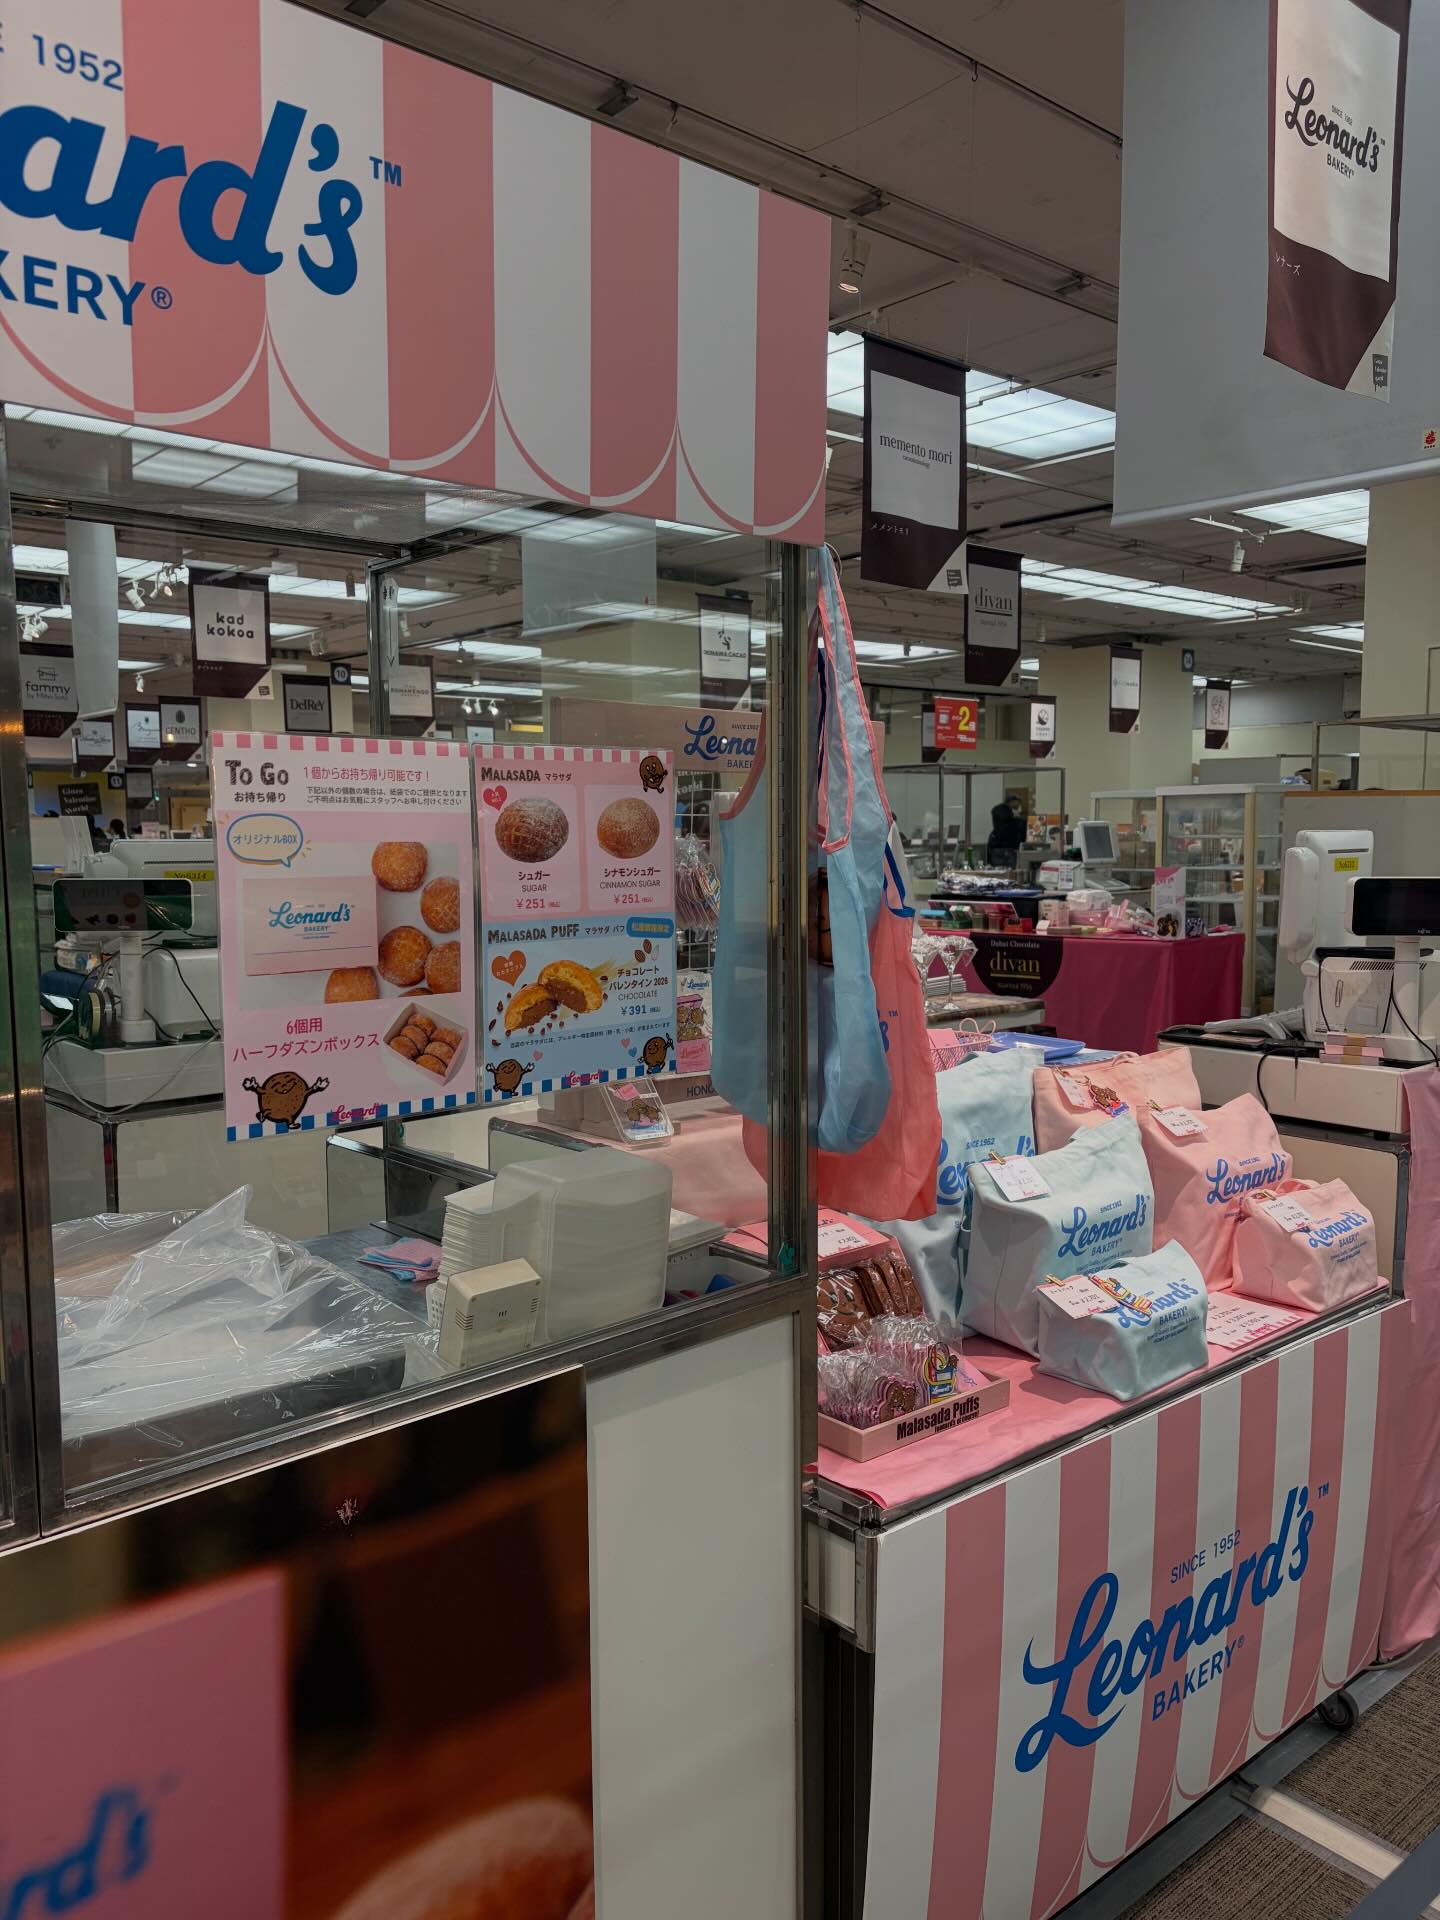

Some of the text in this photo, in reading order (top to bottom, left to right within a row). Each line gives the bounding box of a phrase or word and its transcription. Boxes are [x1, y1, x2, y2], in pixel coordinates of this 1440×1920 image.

[32, 33, 124, 91] 1952
[1284, 74, 1380, 173] Leonard's
[879, 435, 926, 458] memento
[928, 448, 953, 465] mori
[974, 586, 1013, 611] divan
[215, 611, 245, 626] kad
[206, 623, 255, 639] kokoa
[335, 669, 347, 679] 10
[25, 680, 71, 696] fammy
[958, 705, 971, 732] 2
[225, 760, 289, 786] To Go
[481, 766, 573, 782] MALASADA マラサダ
[234, 791, 287, 804] お持ち帰り
[232, 833, 298, 846] オリジナルBOX
[518, 870, 551, 881] シュガー
[603, 866, 662, 878] シナモンシュガー
[521, 884, 548, 893] SUGAR
[599, 879, 661, 890] CINNAMON SUGAR
[268, 901, 351, 929] Leonard's
[487, 927, 547, 945] MALASADA
[551, 923, 580, 938] PUFF
[584, 925, 610, 936] マラサダ
[617, 966, 660, 978] チョコレート
[989, 950, 1041, 974] divan
[608, 979, 653, 992] バレンタイン
[617, 990, 658, 1001] CHOCOLATE
[286, 1017, 323, 1036] 6個用
[232, 1032, 381, 1063] ハーフダズンボックス
[1206, 1152, 1287, 1205] Leonard's
[1058, 1194, 1146, 1258] Leonard's
[896, 1396, 980, 1441] Malasada Puffs
[1170, 1530, 1242, 1584] SINCE 1952
[1015, 1485, 1314, 1773] Leonard's
